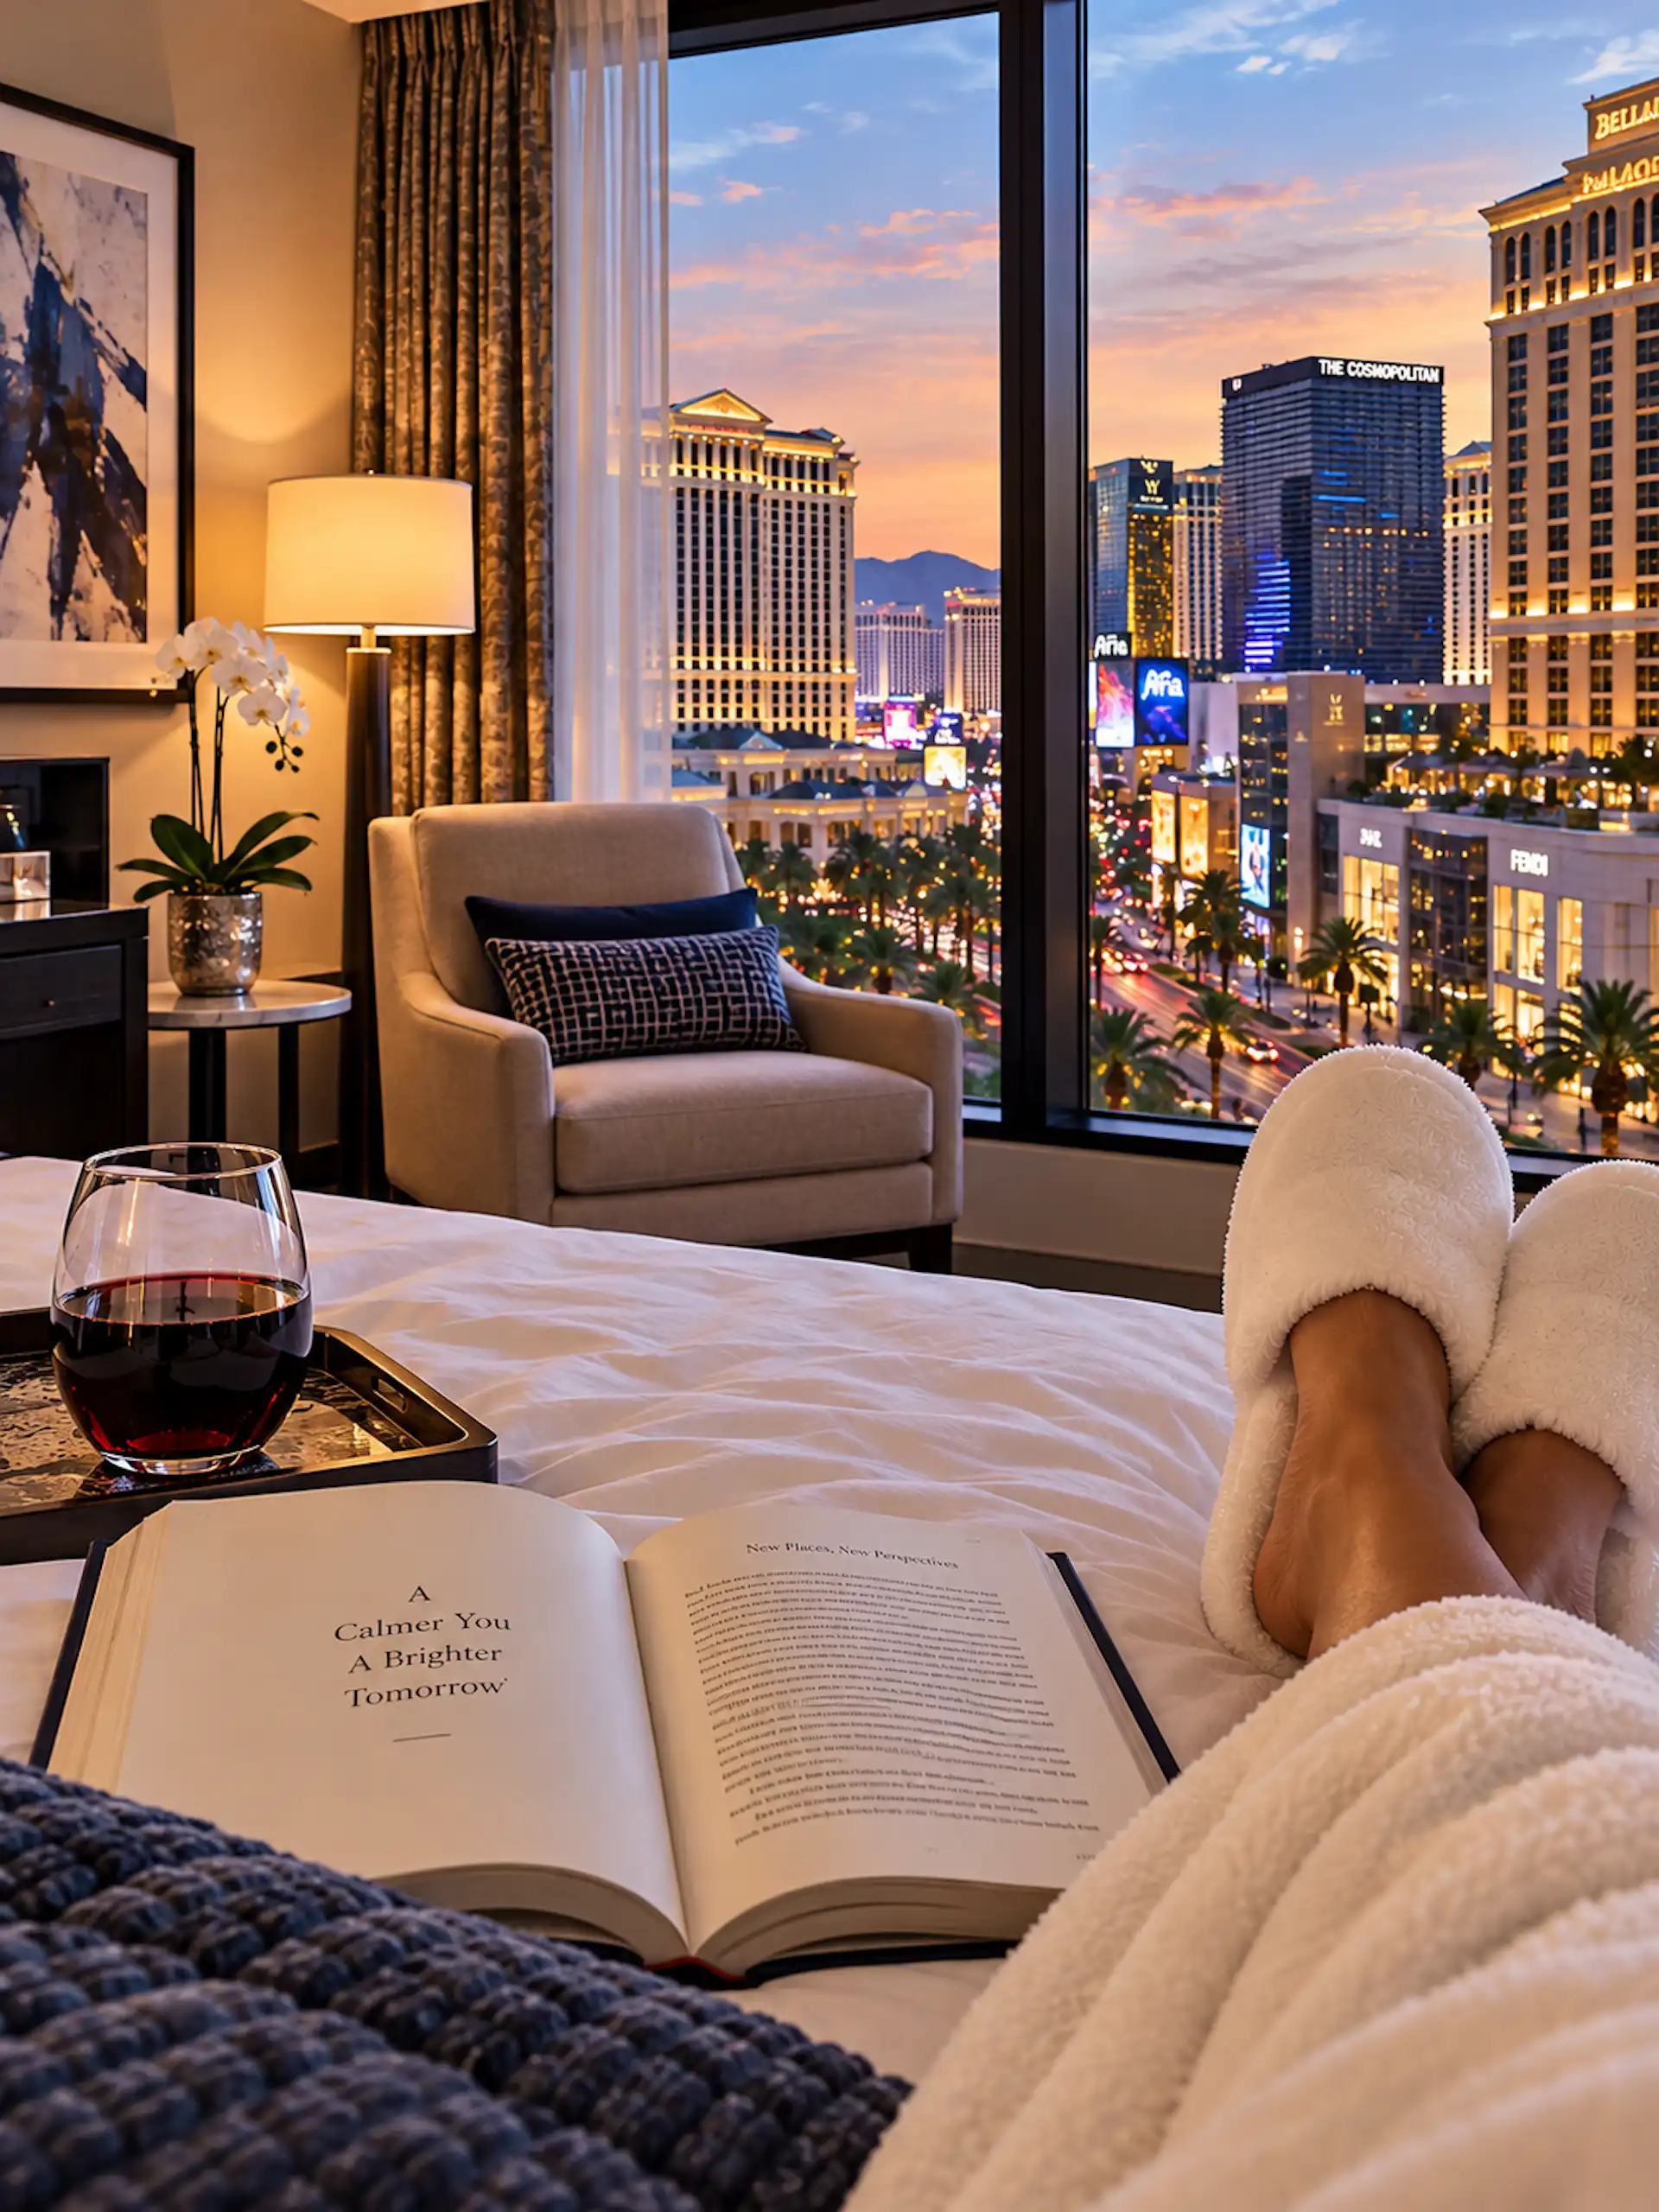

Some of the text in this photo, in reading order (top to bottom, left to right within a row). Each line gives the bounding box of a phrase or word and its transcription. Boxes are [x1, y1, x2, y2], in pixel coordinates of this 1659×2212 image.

[1319, 359, 1440, 383] THE COSMOPOLITAN
[747, 1542, 959, 1570] New Places, New Perspectives
[408, 1586, 431, 1603] A
[334, 1612, 512, 1642] Calmer You
[347, 1645, 503, 1675] A Brighter
